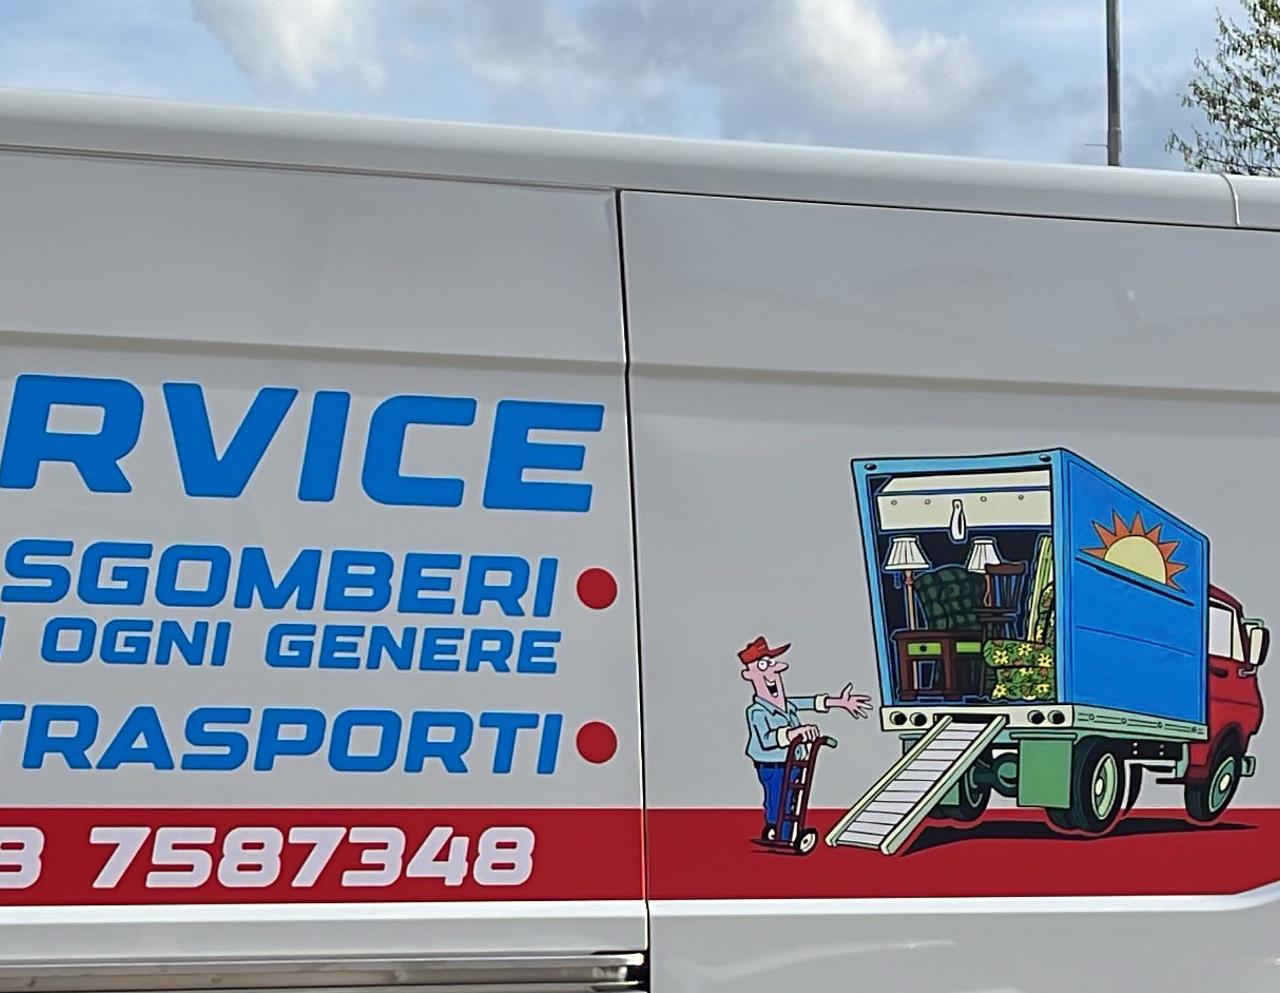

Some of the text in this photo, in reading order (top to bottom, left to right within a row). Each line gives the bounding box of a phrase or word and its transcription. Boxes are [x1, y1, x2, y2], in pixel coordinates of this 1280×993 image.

[0, 538, 559, 618] SGOMBERI
[40, 619, 232, 667] OGNI
[264, 623, 562, 675] GENERE
[89, 826, 535, 889] 7587348
